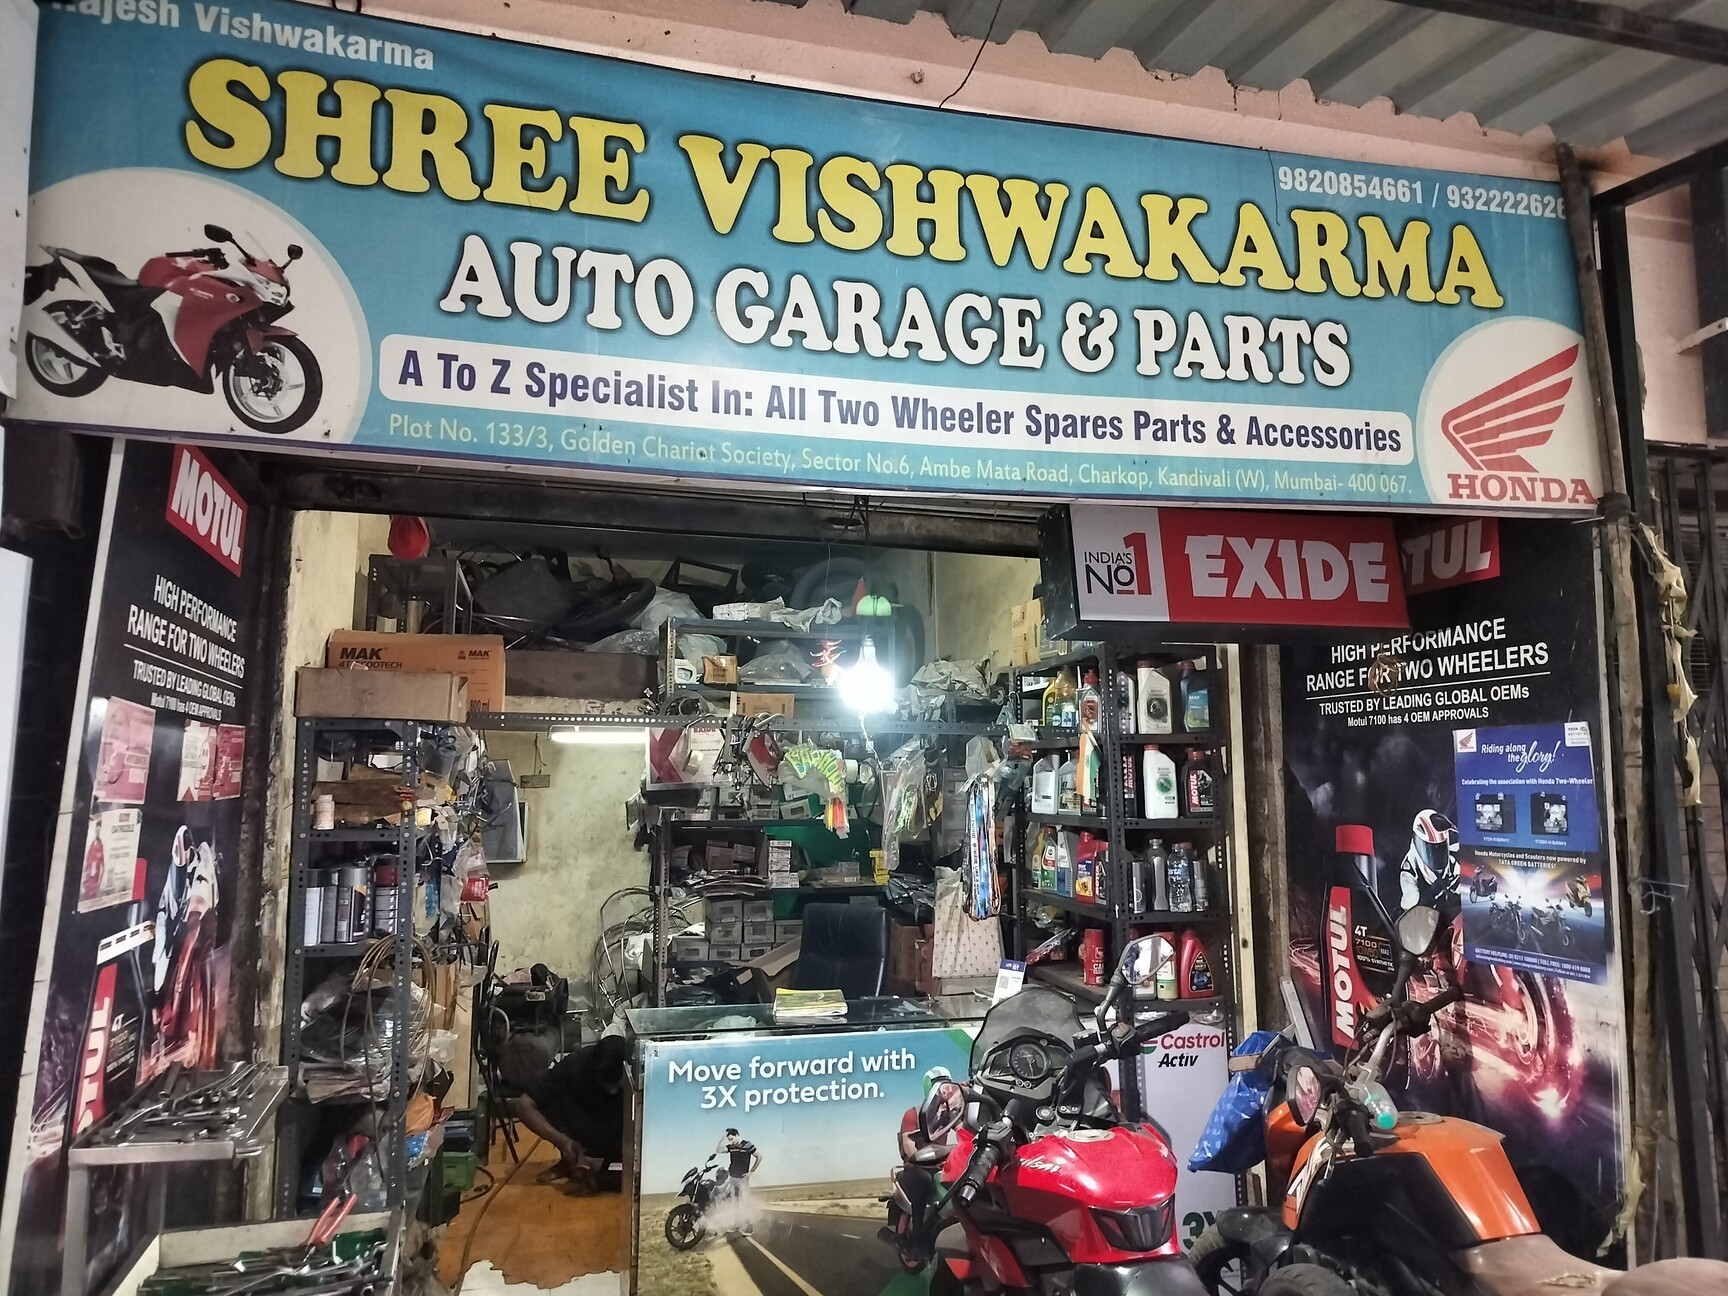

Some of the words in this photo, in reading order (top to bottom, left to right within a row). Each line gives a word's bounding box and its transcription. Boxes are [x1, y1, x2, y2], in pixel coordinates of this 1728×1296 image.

[52, 0, 179, 27] ajesh
[195, 3, 433, 71] Vishwakarma
[185, 58, 651, 223] SHREE
[678, 133, 1505, 309] VISHWAKARMA
[1278, 166, 1423, 204] 9820854661
[1431, 183, 1440, 207] /
[439, 234, 694, 337] AUTO
[715, 267, 1046, 371] GARAGE
[1061, 301, 1118, 373] &
[1133, 308, 1352, 388] PARTS
[398, 349, 423, 387] A
[437, 352, 476, 392] To
[490, 358, 511, 395] Z
[525, 361, 698, 413] Specialist
[711, 379, 753, 417] In:
[766, 385, 806, 421] All
[818, 389, 880, 427] Two
[891, 395, 1015, 435] Wheeler
[1025, 404, 1124, 445] Spares
[1133, 410, 1207, 444] Parts
[1216, 413, 1237, 446] &
[1246, 416, 1402, 453] Accessories
[389, 413, 433, 439] Plot
[440, 417, 478, 444] No.
[486, 421, 553, 453] 133/3,
[561, 428, 636, 455] Golden
[642, 435, 716, 462] Chariot
[721, 441, 796, 472] Society,
[802, 447, 861, 472] Sector
[875, 453, 914, 479] No.6,
[920, 456, 972, 479] Ambe
[976, 459, 1022, 481] Mata
[1026, 462, 1074, 485] Road,
[1079, 464, 1153, 490] Charkop,
[1158, 468, 1231, 488] Kandivali
[1235, 468, 1270, 493] (W),
[1274, 470, 1344, 491] Mumbai-
[1348, 474, 1376, 493] 400
[1380, 475, 1412, 494] 067.
[170, 449, 244, 565] MOTUL
[1447, 473, 1598, 505] HONDA
[1084, 551, 1133, 565] INDIA'S
[1123, 532, 1152, 596] 1
[1185, 534, 1390, 603] EXIDE
[1400, 519, 1491, 586] TUL
[153, 574, 180, 612] HIGH
[179, 589, 237, 643] PERFORMANCE
[127, 604, 168, 647] RANGE
[166, 622, 188, 655] FOR
[188, 632, 208, 663] TWO
[208, 641, 246, 679] WHEELERS
[340, 647, 383, 660] MAK
[1331, 644, 1366, 664] HIGH
[133, 659, 167, 687] TRUSTED
[166, 670, 178, 690] BY
[176, 674, 203, 698] LEADING
[1306, 668, 1355, 692] RANGE
[1437, 642, 1549, 677] WHEELERS
[1319, 699, 1364, 716] TRUSTED
[1366, 697, 1381, 712] BY
[1383, 691, 1432, 711] LEADING
[1435, 687, 1488, 707] GLOBAL
[1490, 683, 1530, 700] OEMs
[1347, 716, 1368, 727] Motul
[1368, 714, 1387, 726] 7100
[1388, 713, 1402, 725] has
[1404, 712, 1409, 723] 4
[1410, 711, 1431, 723] OEM
[1432, 706, 1489, 721] APPROVALS
[1481, 743, 1504, 755] Riding
[1505, 743, 1526, 754] along
[1507, 753, 1519, 763] the
[1515, 740, 1561, 773] glory!
[1189, 774, 1200, 805] MOTUL
[1461, 778, 1489, 786] Celebrating
[1354, 925, 1368, 937] 4T
[1355, 938, 1378, 949] 7100
[1329, 904, 1355, 1040] MOTUL
[1161, 1031, 1226, 1050] Castrol
[668, 1059, 742, 1083] Move
[749, 1051, 855, 1079] forward
[861, 1047, 917, 1072] with
[1158, 1052, 1199, 1068] Activ
[700, 1085, 739, 1110] 3X
[744, 1078, 885, 1113] protection.
